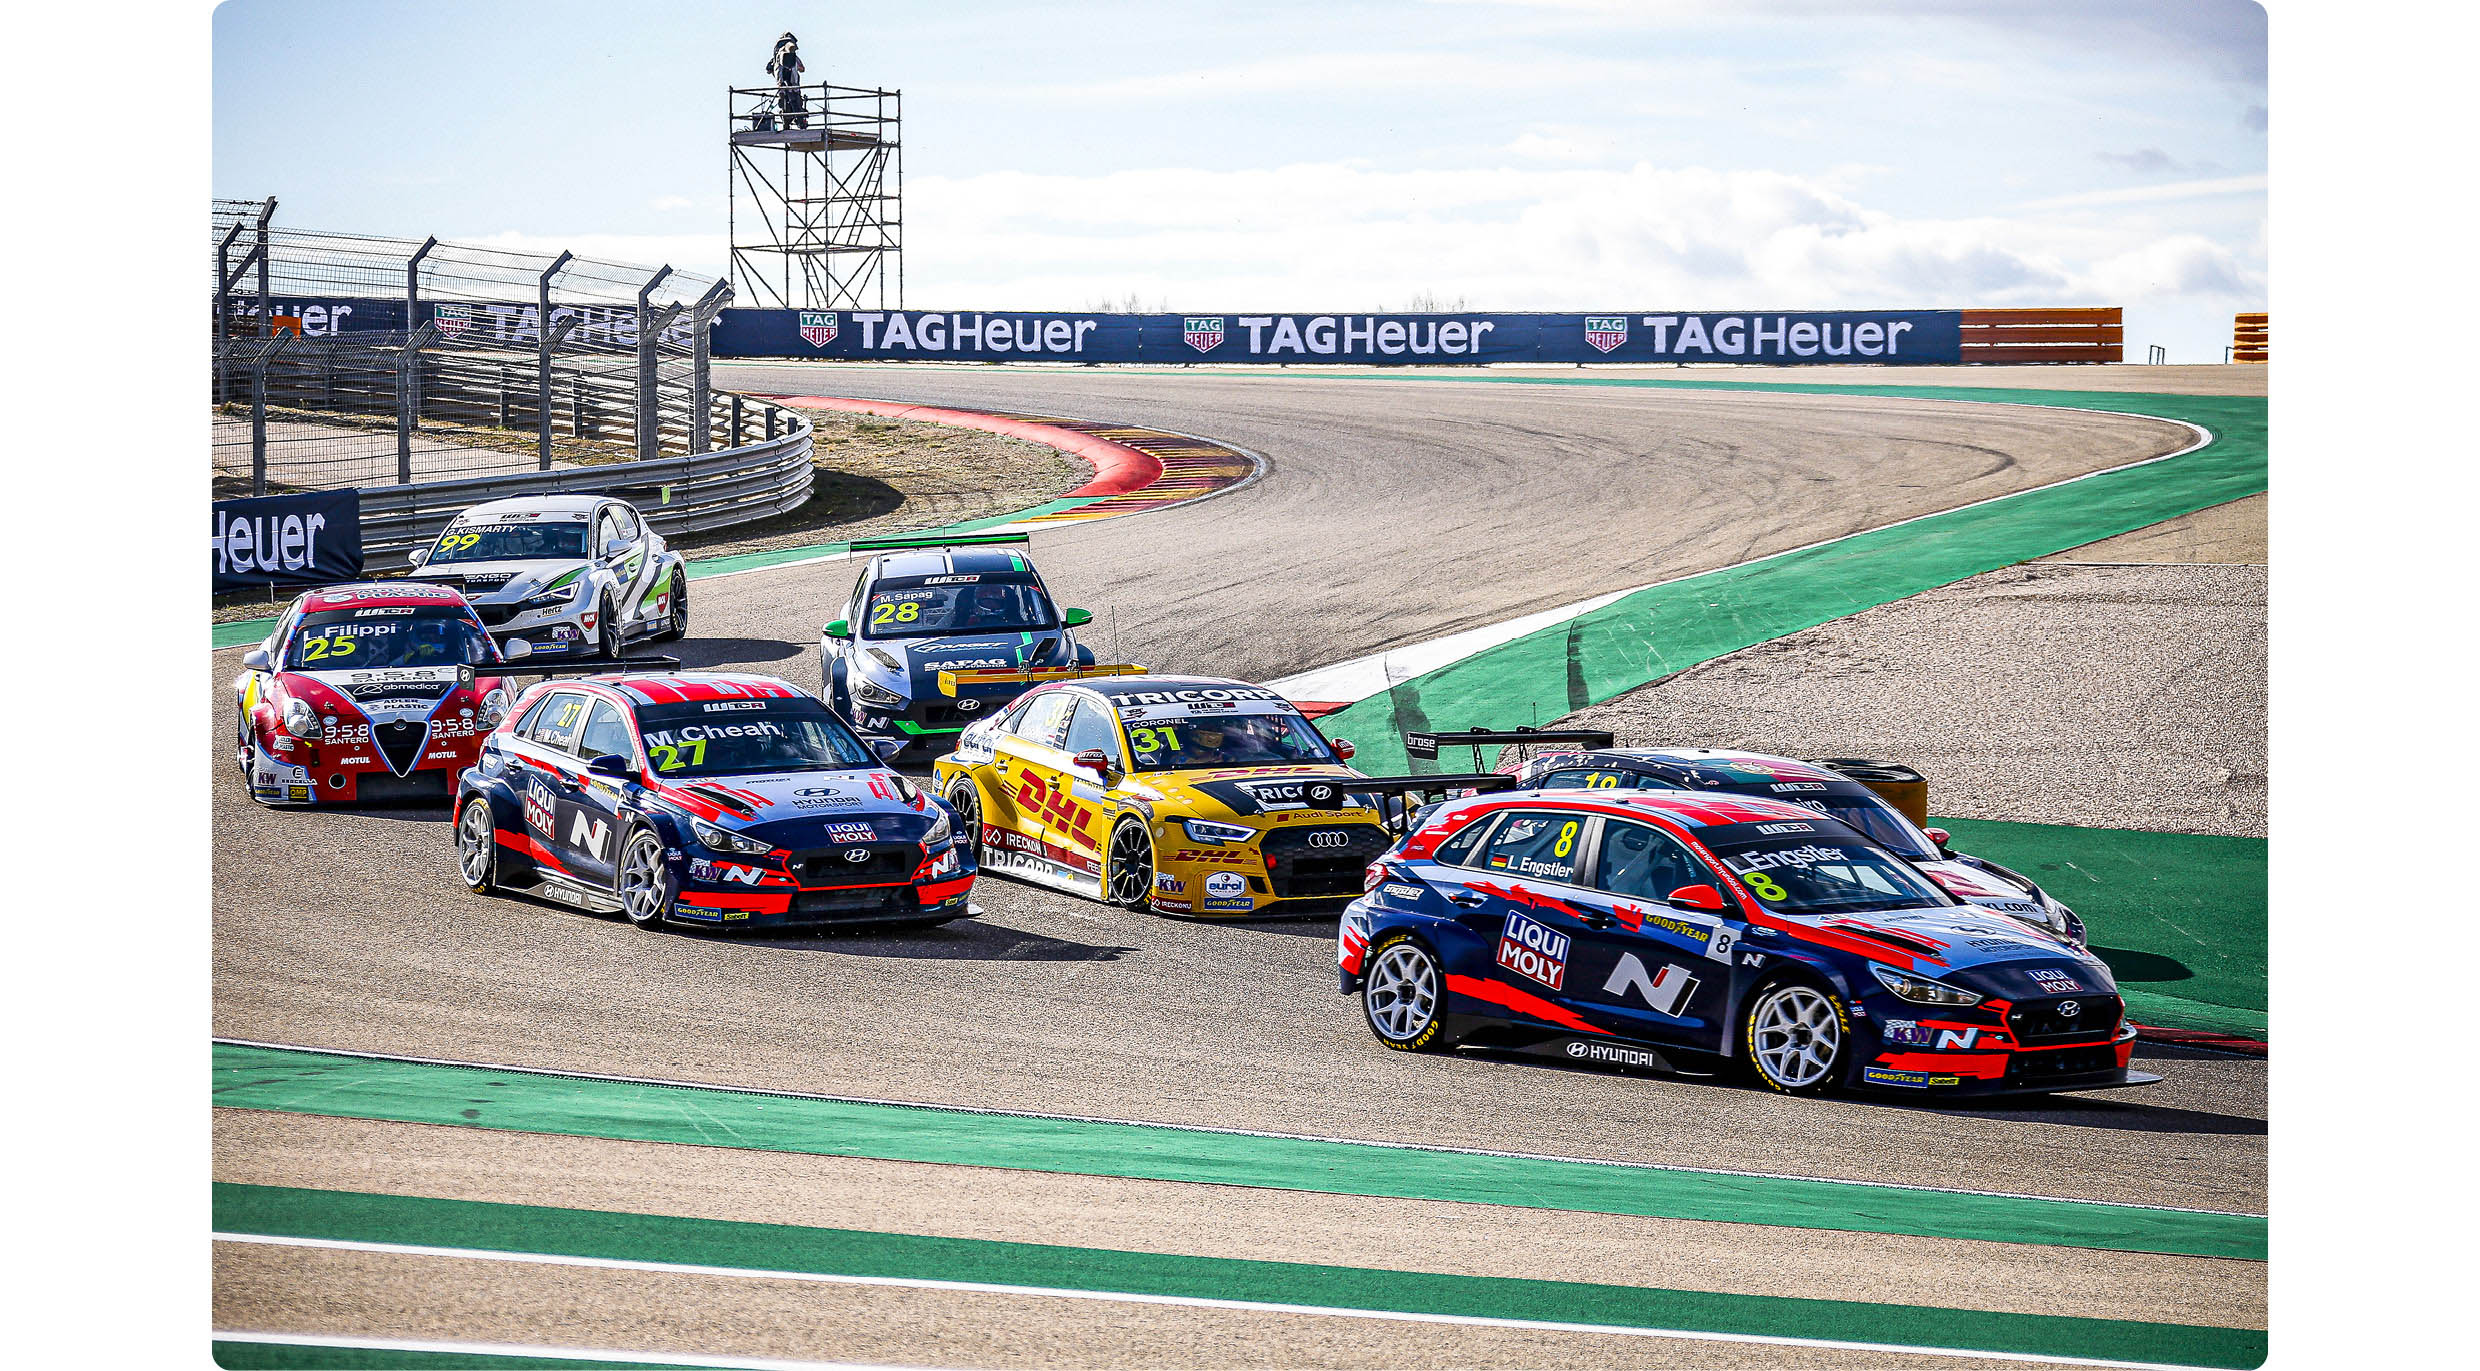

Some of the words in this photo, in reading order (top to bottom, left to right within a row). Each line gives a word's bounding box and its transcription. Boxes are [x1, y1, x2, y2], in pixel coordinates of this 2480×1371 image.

[803, 315, 835, 326] TAG
[1187, 319, 1220, 331] TAG
[1588, 319, 1623, 331] TAG
[802, 327, 836, 345] HEUER
[1186, 333, 1222, 350] HEUER
[1587, 333, 1624, 350] HEUER
[438, 533, 481, 553] 99
[880, 591, 933, 604] M.Sapag
[542, 605, 562, 617] Hertz
[874, 602, 920, 625] 28
[304, 635, 357, 662] 25
[383, 683, 439, 691] abmedica
[1109, 688, 1277, 706] TRICORP
[556, 703, 581, 728] 27
[324, 737, 369, 745] SANTERO
[431, 730, 475, 739] SANTERO
[643, 721, 780, 749] M.Cheah
[1131, 726, 1181, 753] 31
[1407, 733, 1436, 748] brose
[340, 757, 371, 765] MOTUL
[428, 751, 457, 760] MOTUL
[649, 739, 707, 772] 27
[257, 772, 277, 785] KW
[528, 778, 555, 816] LIQUI
[792, 796, 861, 806] HYUNDAI
[1016, 767, 1097, 851] DHL
[1293, 810, 1323, 819] Audi
[1325, 810, 1363, 819] Sport
[526, 801, 554, 837] MOLY
[828, 823, 870, 833] LIQUI
[833, 832, 875, 842] MOLY
[1554, 821, 1578, 858] 8
[1174, 849, 1245, 865] DHL
[694, 864, 721, 881] KW
[1690, 840, 1749, 901] motorsport.hyundai.com
[1158, 880, 1187, 892] KW
[1209, 882, 1242, 891] eurol
[1744, 871, 1788, 902] 8
[553, 887, 582, 905] HYUNDAI
[1206, 900, 1251, 908] GOODYEAR
[677, 907, 719, 918] GOODYEAR
[1645, 913, 1710, 943] GOODYEAR
[1506, 913, 1567, 961] LIQUI
[1716, 933, 1731, 954] 8
[1499, 940, 1563, 985] MOLY
[2028, 969, 2069, 982] LIQUI
[2043, 981, 2082, 994] MOLY
[1893, 1027, 1934, 1044] KW
[1590, 1044, 1653, 1068] HYUNDAI
[1867, 1071, 1926, 1083] GOODYEAR
